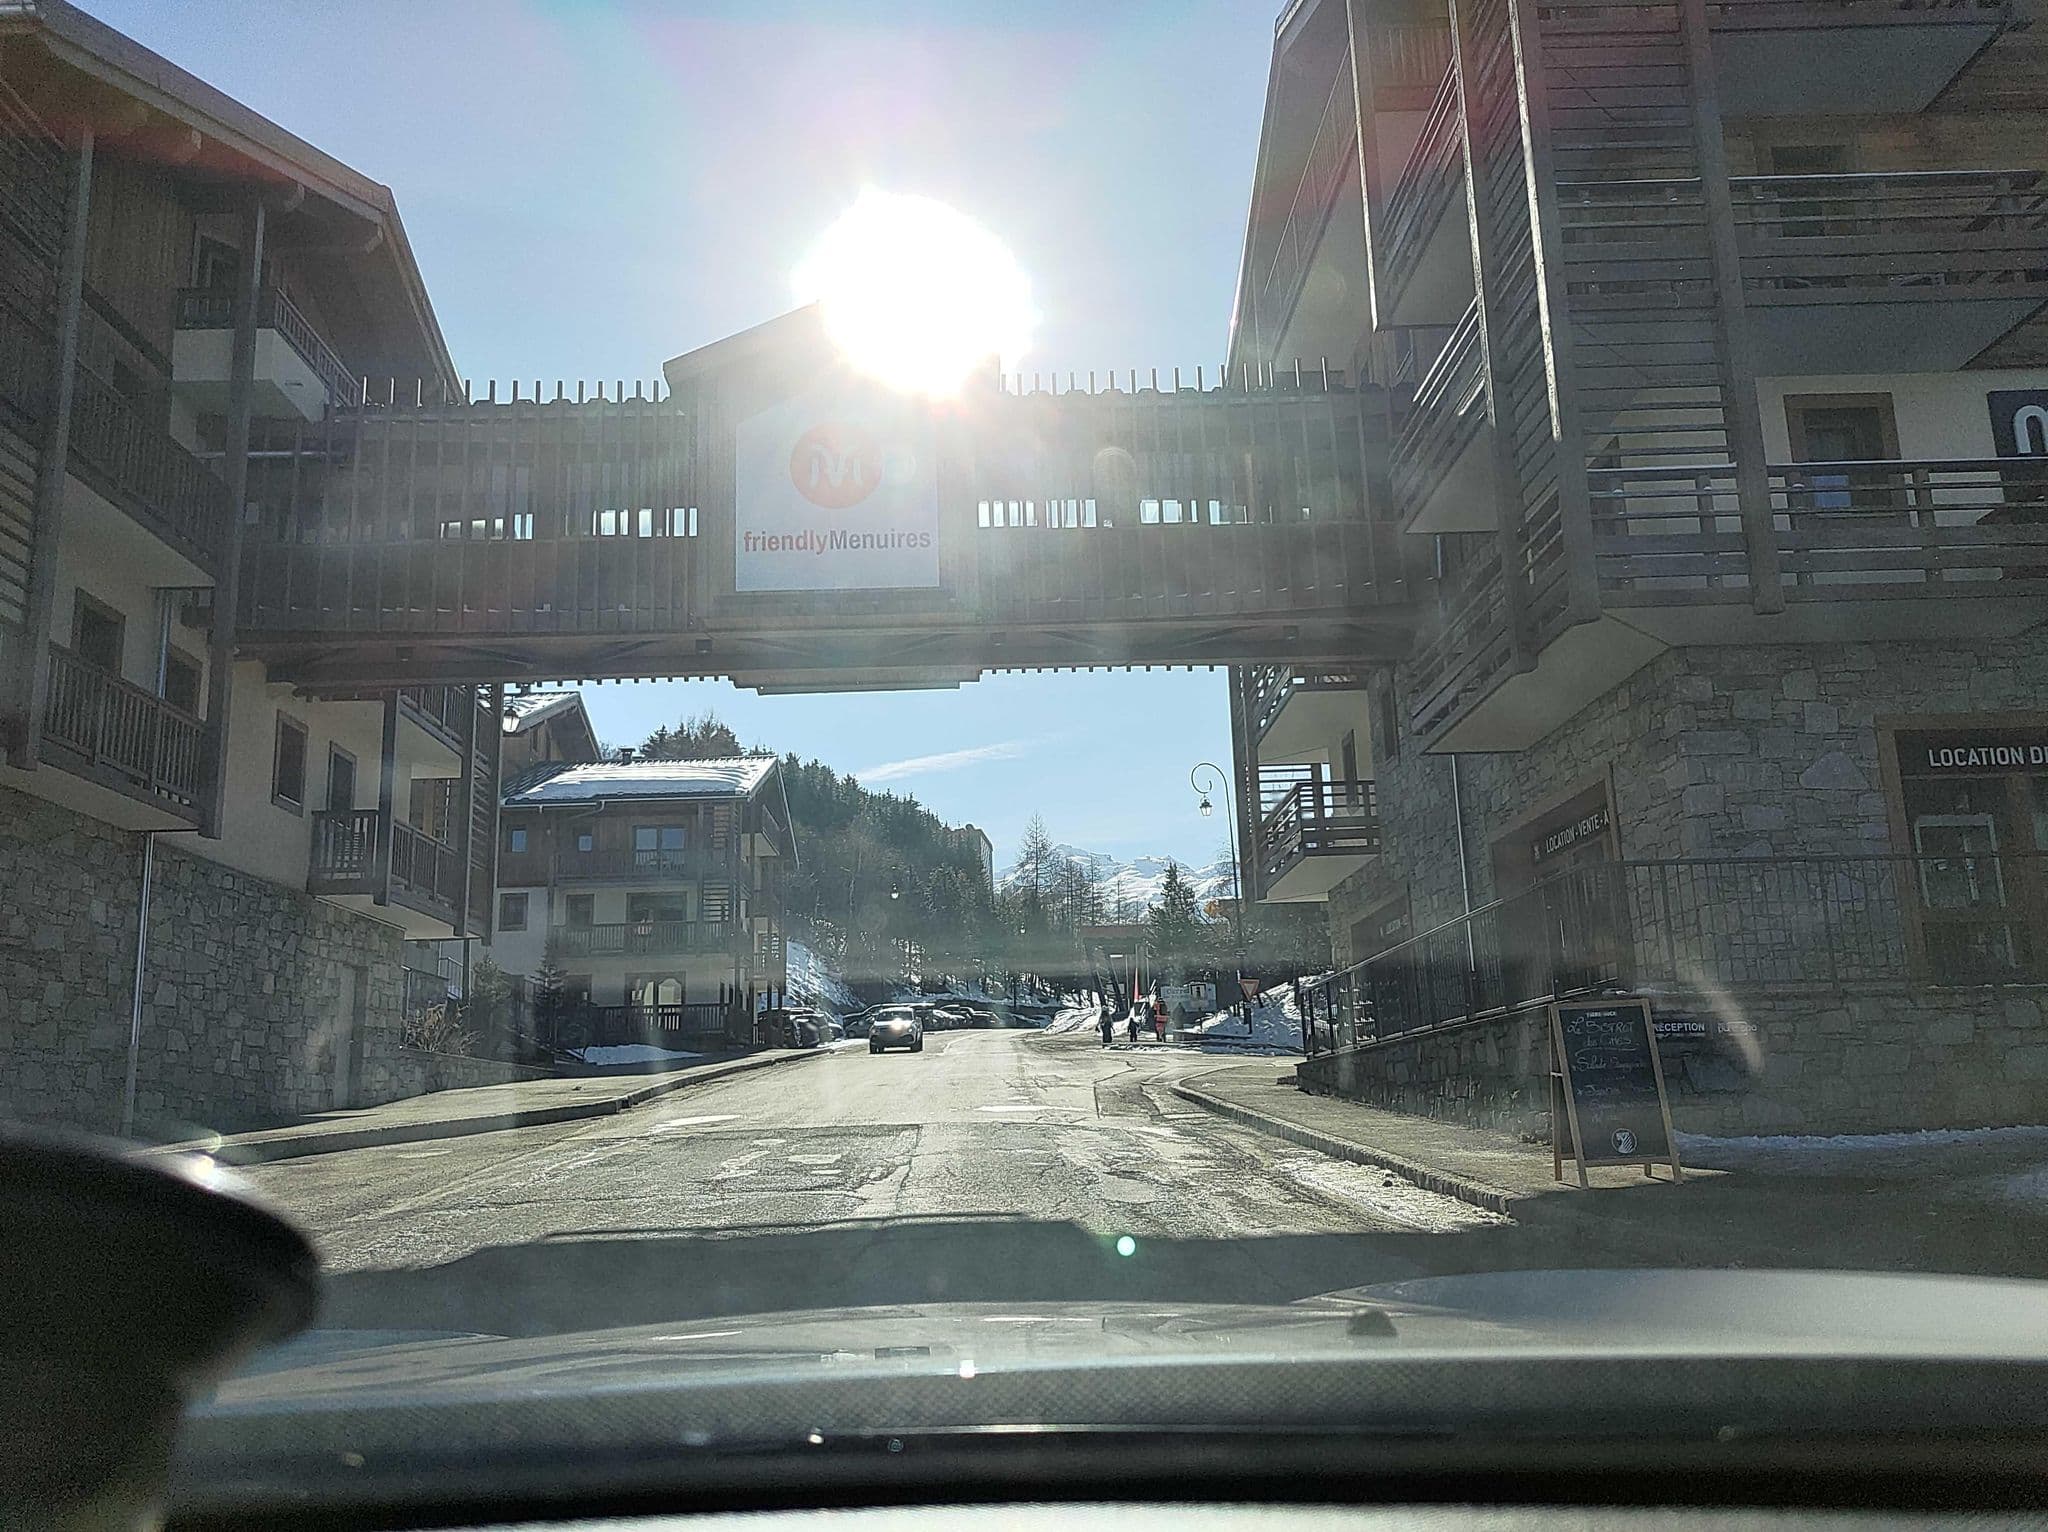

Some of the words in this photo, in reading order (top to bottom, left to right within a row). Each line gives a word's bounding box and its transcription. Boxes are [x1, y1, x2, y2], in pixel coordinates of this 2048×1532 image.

[743, 528, 931, 555] friendlyMenuires
[1928, 746, 2024, 767] LOCATION
[1545, 825, 1576, 853] LOCATION
[1577, 814, 1600, 837] VENTE
